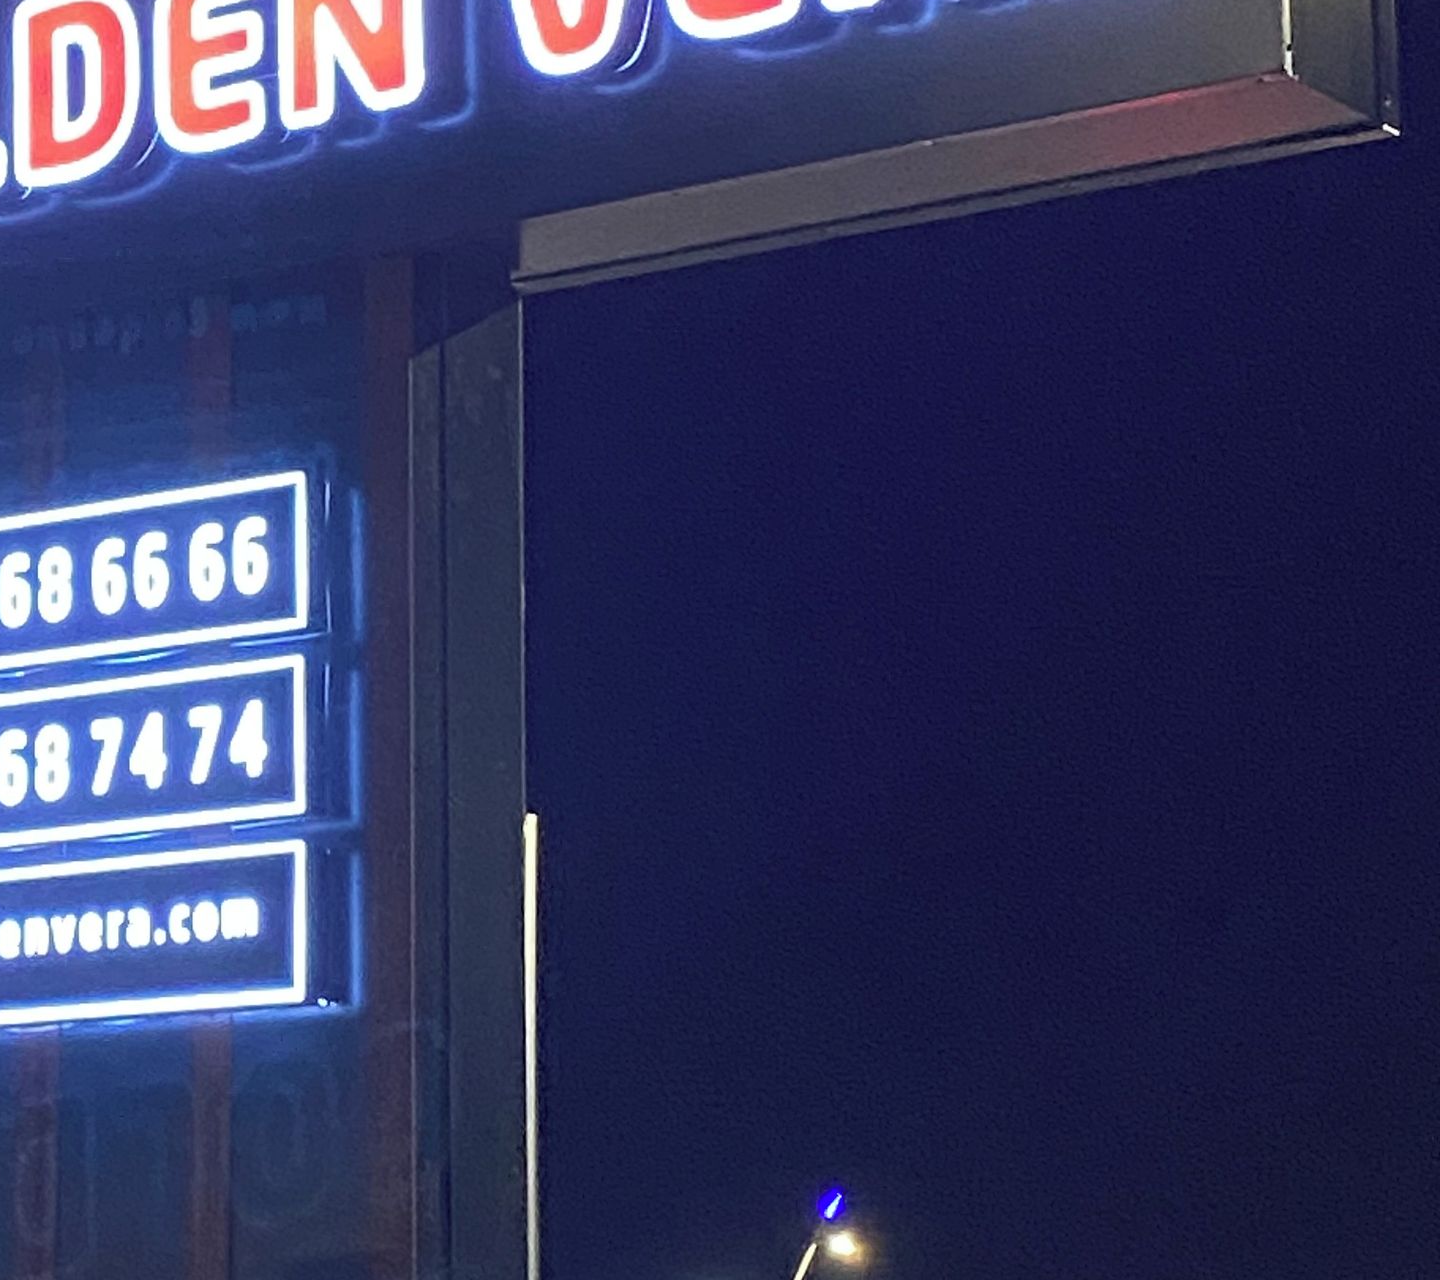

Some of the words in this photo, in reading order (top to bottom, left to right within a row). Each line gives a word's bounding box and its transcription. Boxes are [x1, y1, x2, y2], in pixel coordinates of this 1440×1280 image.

[90, 530, 170, 616] 66
[188, 515, 270, 602] 66
[89, 711, 168, 796] 74
[187, 698, 269, 785] 74
